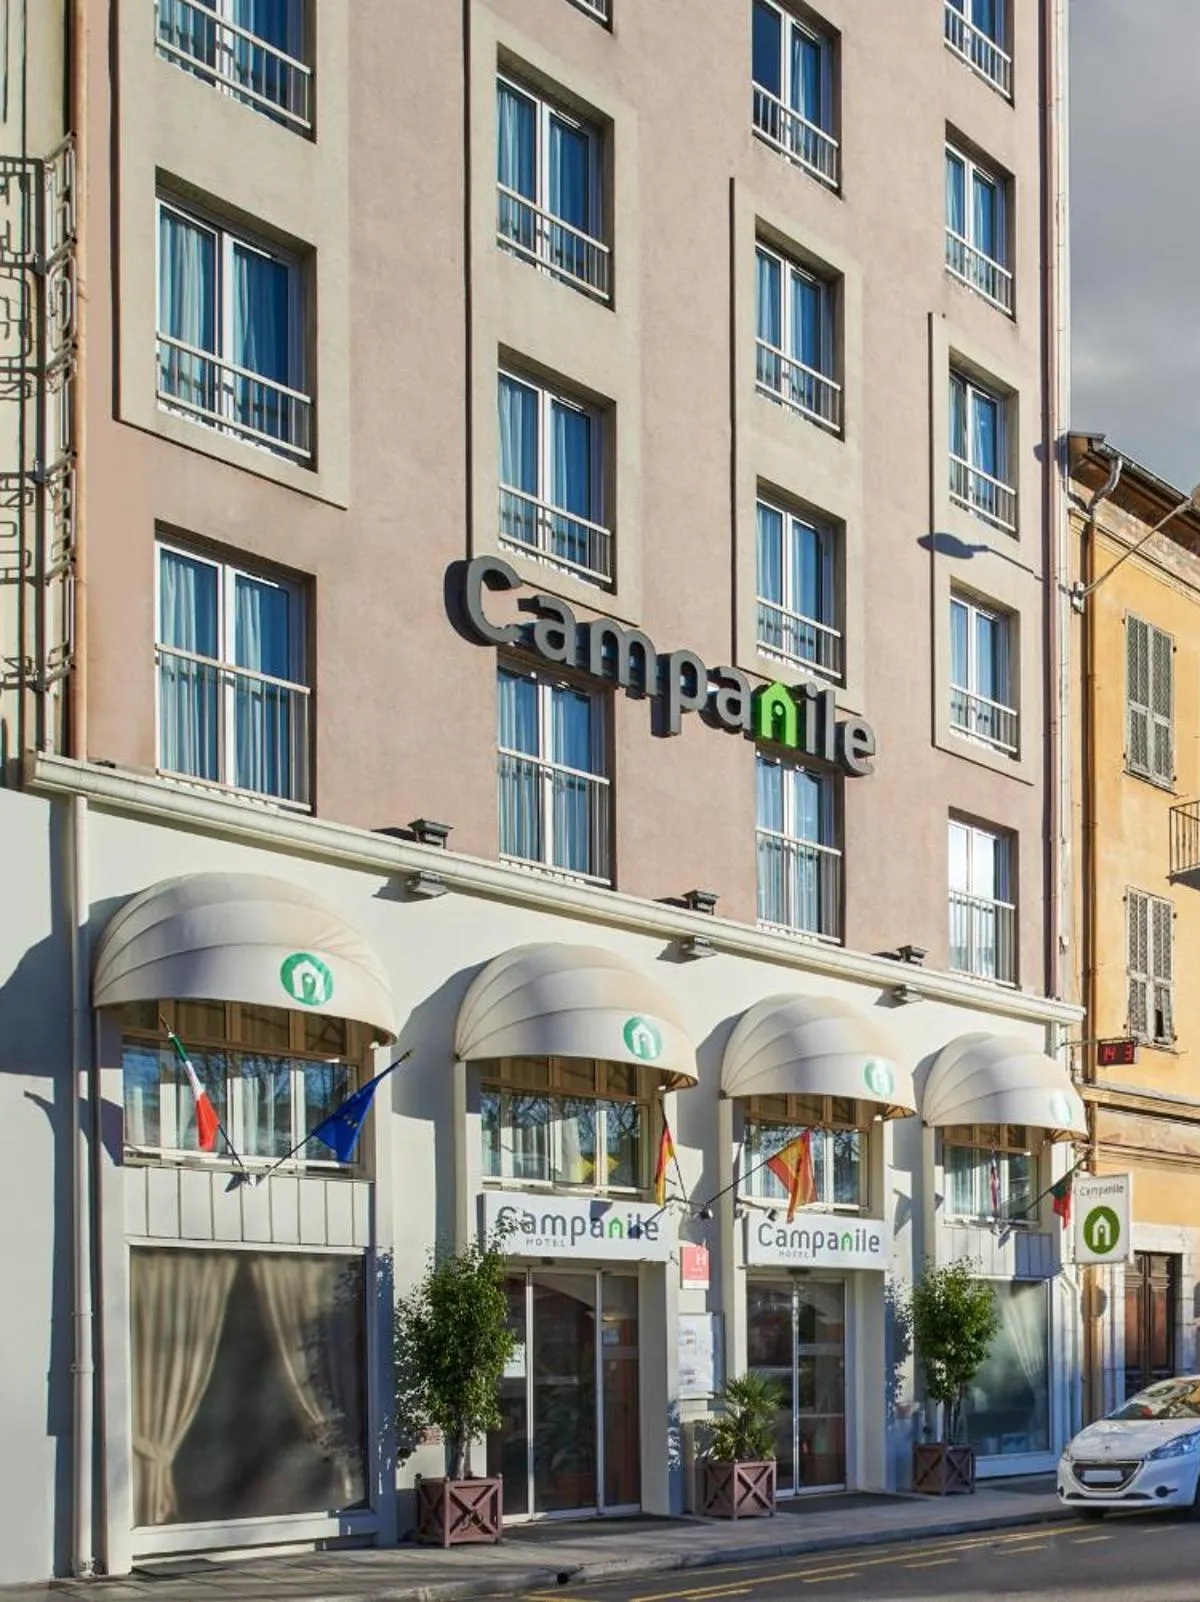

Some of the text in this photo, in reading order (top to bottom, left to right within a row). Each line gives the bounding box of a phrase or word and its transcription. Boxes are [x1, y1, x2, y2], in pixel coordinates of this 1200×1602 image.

[444, 554, 876, 777] Campanile
[1079, 1183, 1124, 1198] Campanile
[525, 1237, 566, 1248] HOTEL
[758, 1223, 880, 1257] Campanile
[779, 1250, 809, 1258] HOTEL
